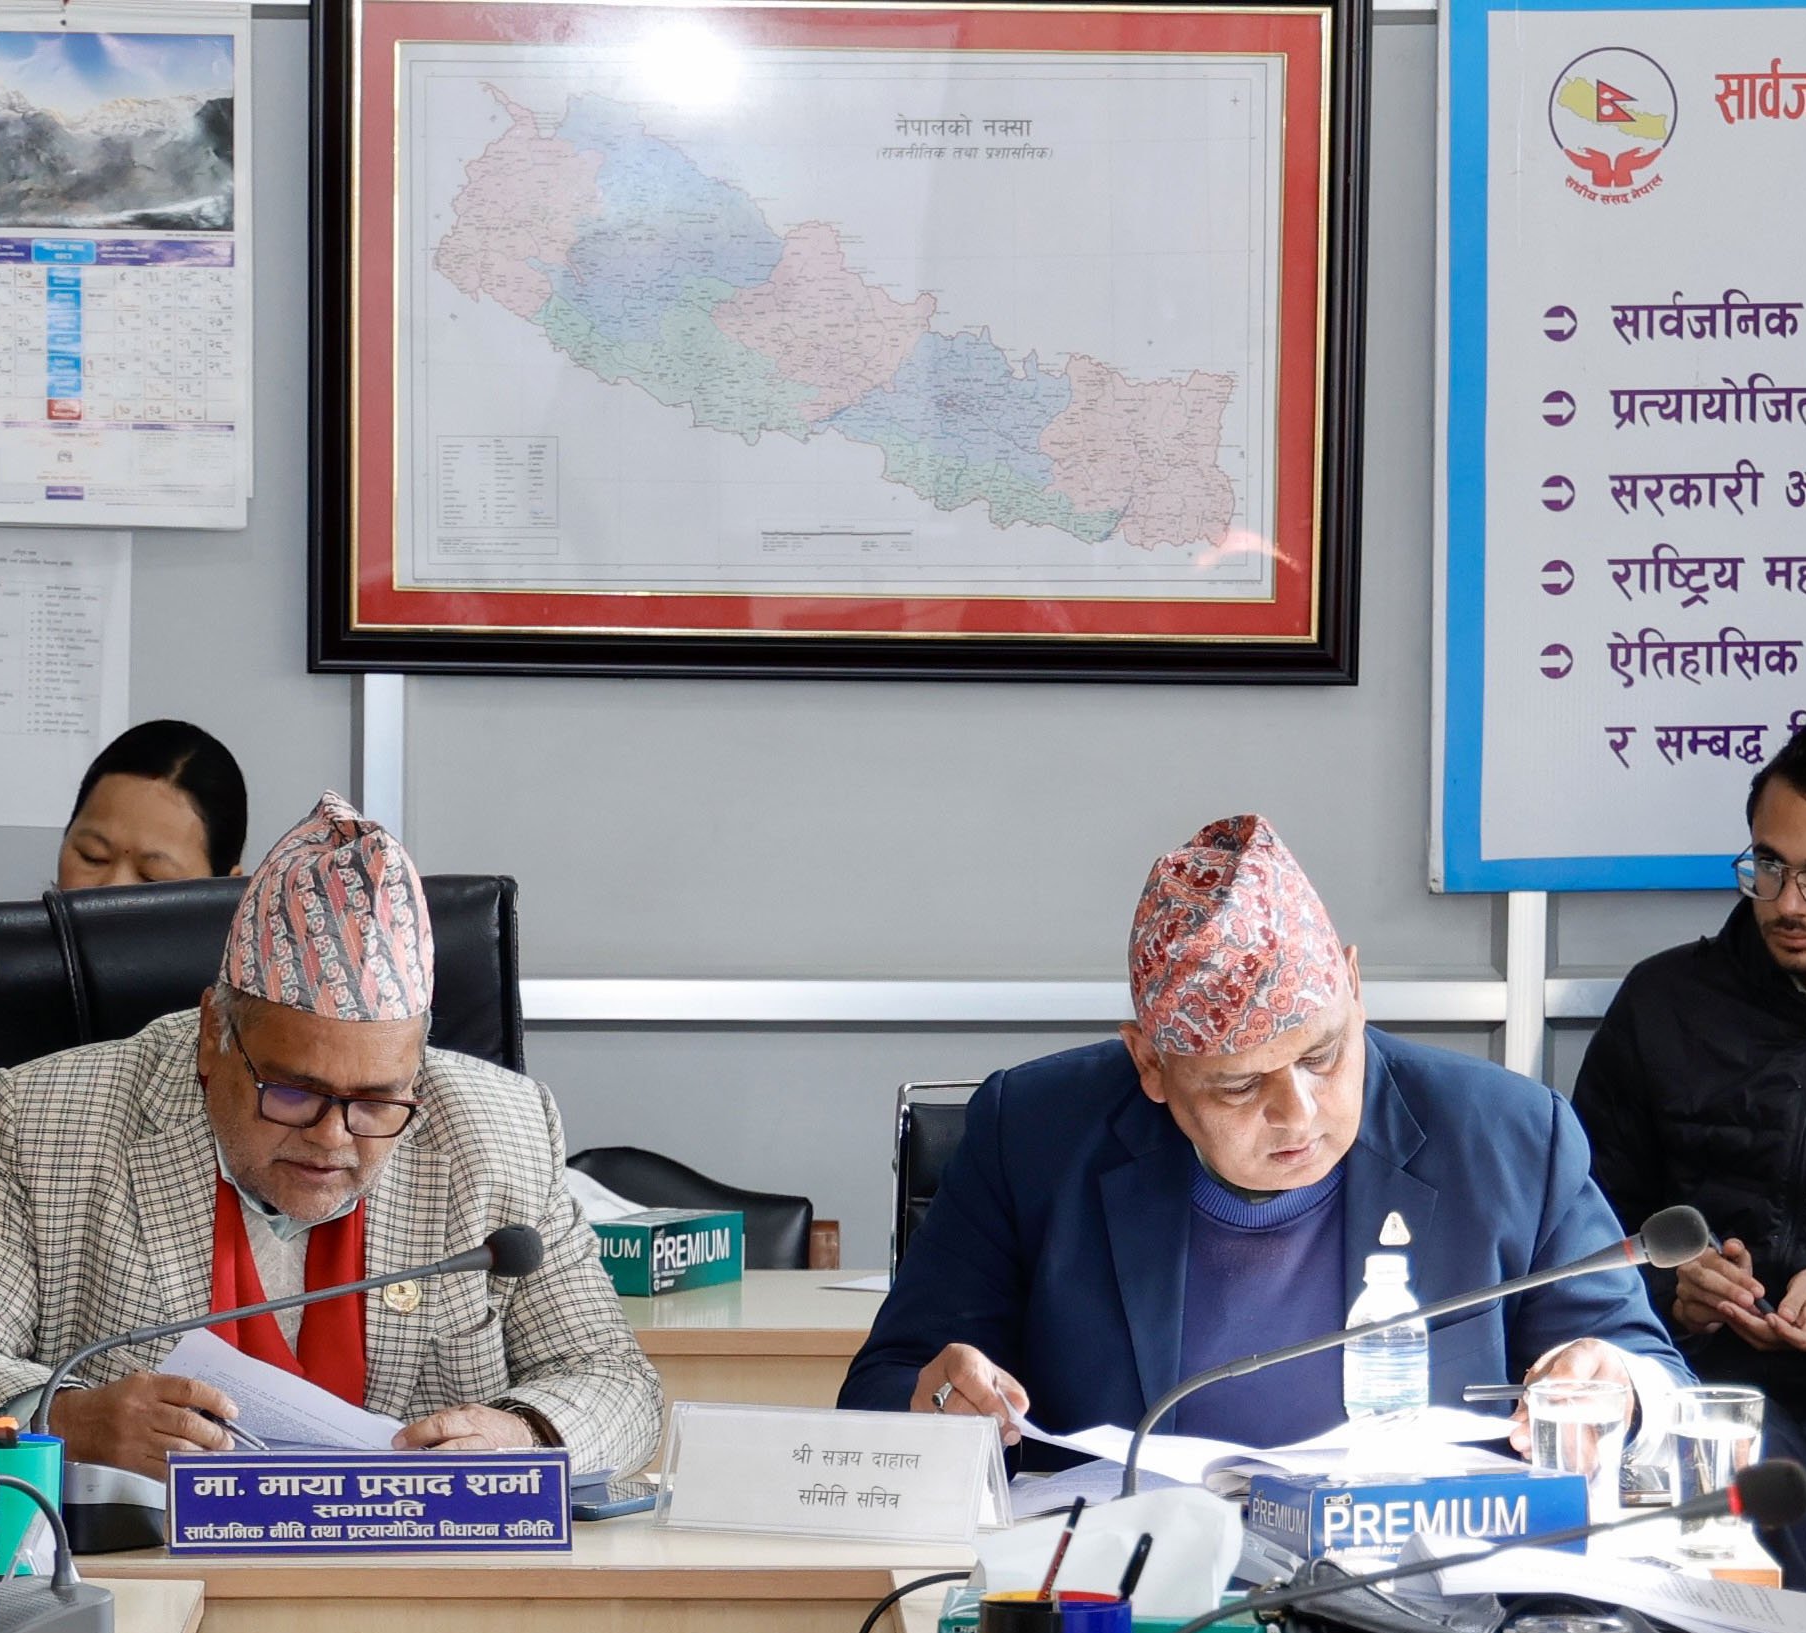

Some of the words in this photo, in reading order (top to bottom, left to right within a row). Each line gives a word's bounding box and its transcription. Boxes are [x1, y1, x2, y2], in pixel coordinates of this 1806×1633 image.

[895, 113, 972, 137] नेपालको
[983, 119, 1032, 137] नक्सा
[1611, 289, 1804, 344] सार्वजनिक
[1609, 459, 1765, 516] सरकारी
[1607, 543, 1745, 608] राष्ट्रिय
[1607, 627, 1803, 688] ऐतिहासिक
[1605, 725, 1637, 768] र
[1655, 724, 1768, 765] सम्बद्ध
[652, 1227, 730, 1272] PREMIUM
[791, 1443, 813, 1465] श्री
[871, 1452, 922, 1470] दाहाल
[194, 1477, 245, 1496] मा.
[258, 1476, 345, 1495] माया
[357, 1475, 454, 1498] प्रसाद
[466, 1469, 542, 1495] शर्मा
[797, 1483, 848, 1507] समिति
[856, 1486, 902, 1509] सचिव
[183, 1524, 263, 1539] सार्वजनिक
[268, 1523, 305, 1538] नीति
[310, 1525, 342, 1538] तथा
[347, 1521, 434, 1539] प्रत्यायोजित
[439, 1519, 499, 1537] विधायन
[504, 1518, 555, 1537] समिति
[312, 1500, 426, 1519] सभापति
[1252, 1497, 1306, 1536] PREMIUM
[1323, 1495, 1527, 1547] PREMIUM
